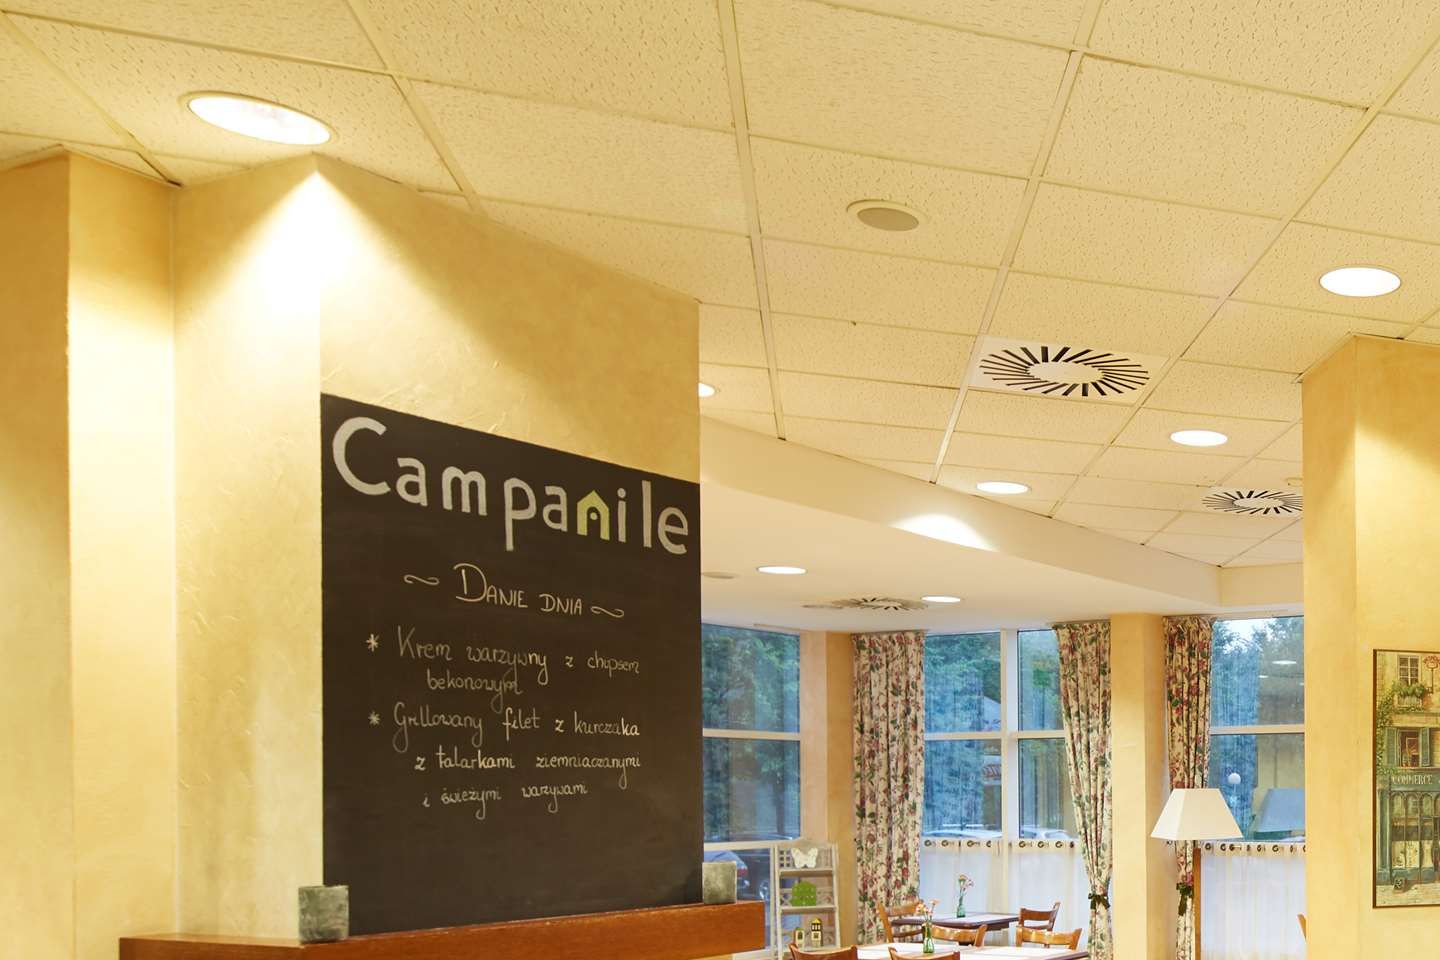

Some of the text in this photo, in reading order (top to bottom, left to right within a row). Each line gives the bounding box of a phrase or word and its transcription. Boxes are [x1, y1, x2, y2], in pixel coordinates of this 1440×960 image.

[332, 416, 689, 555] Campanile
[539, 592, 583, 616] DNIA
[397, 625, 639, 685] Krem warzywny z chipsem
[426, 669, 523, 713] bekonowym
[393, 701, 640, 752] Grillowany filet z kurczaka
[414, 757, 426, 771] z
[435, 744, 516, 769] talarkami
